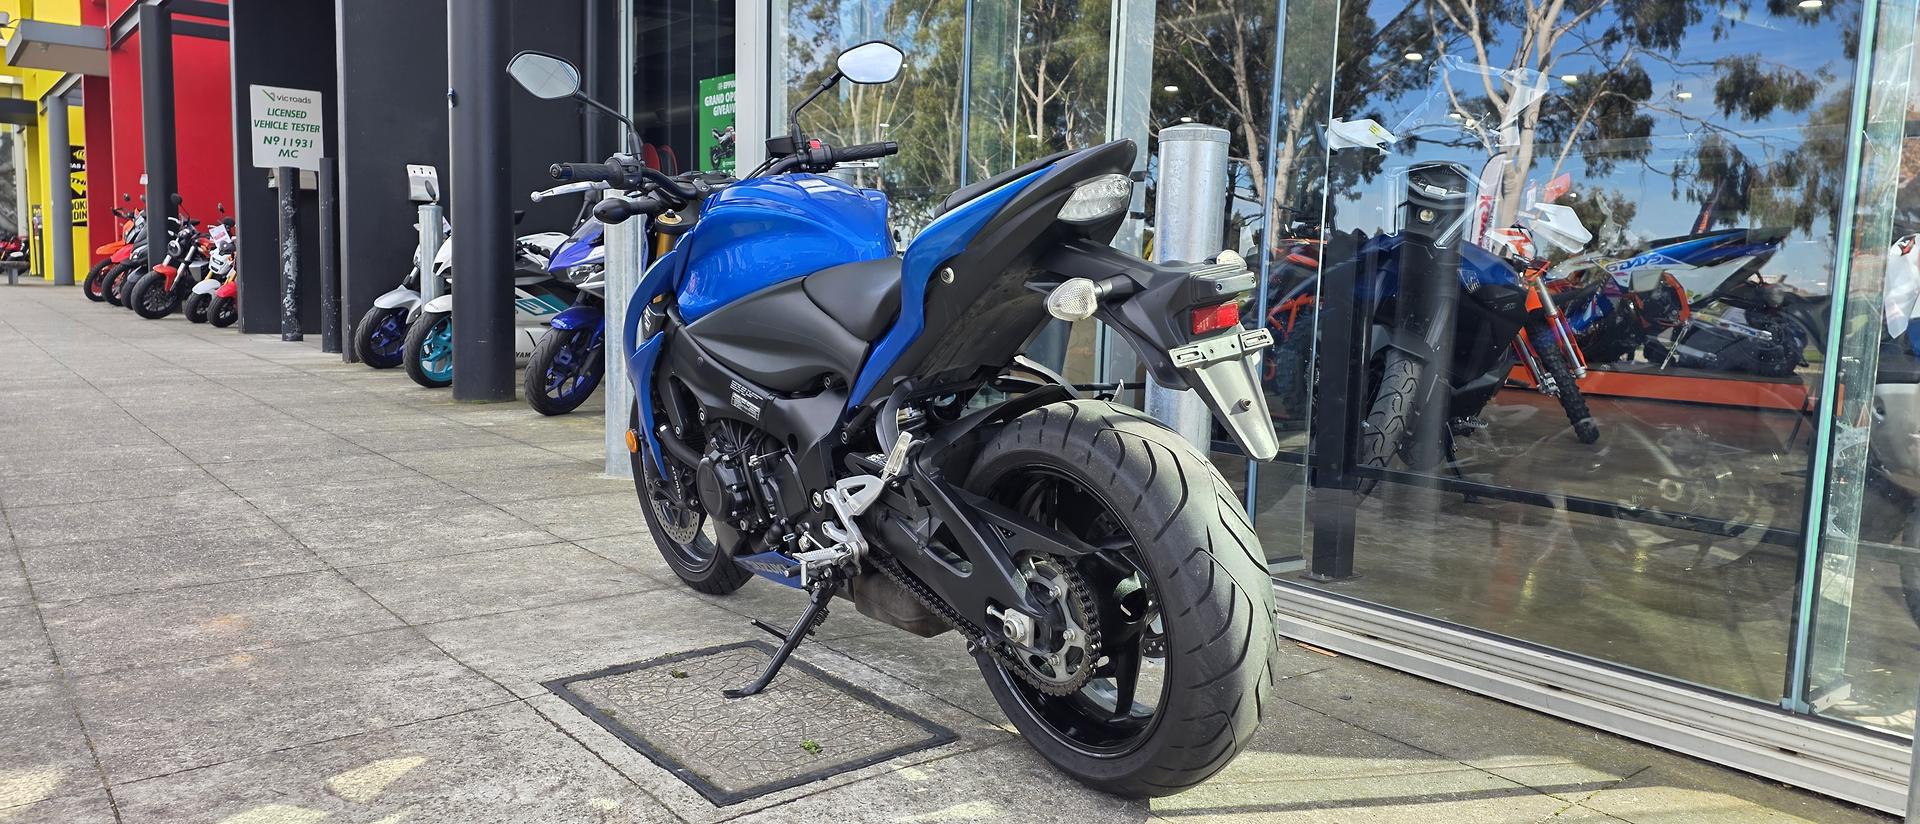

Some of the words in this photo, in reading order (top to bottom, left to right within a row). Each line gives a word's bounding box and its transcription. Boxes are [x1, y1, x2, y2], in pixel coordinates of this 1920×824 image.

[276, 94, 312, 104] vicroads
[705, 94, 724, 106] GRAND
[267, 107, 307, 119] LICENSED
[253, 119, 288, 131] VEHICLE
[291, 122, 321, 133] TESTER
[283, 137, 313, 149] 11931
[278, 148, 299, 159] MC
